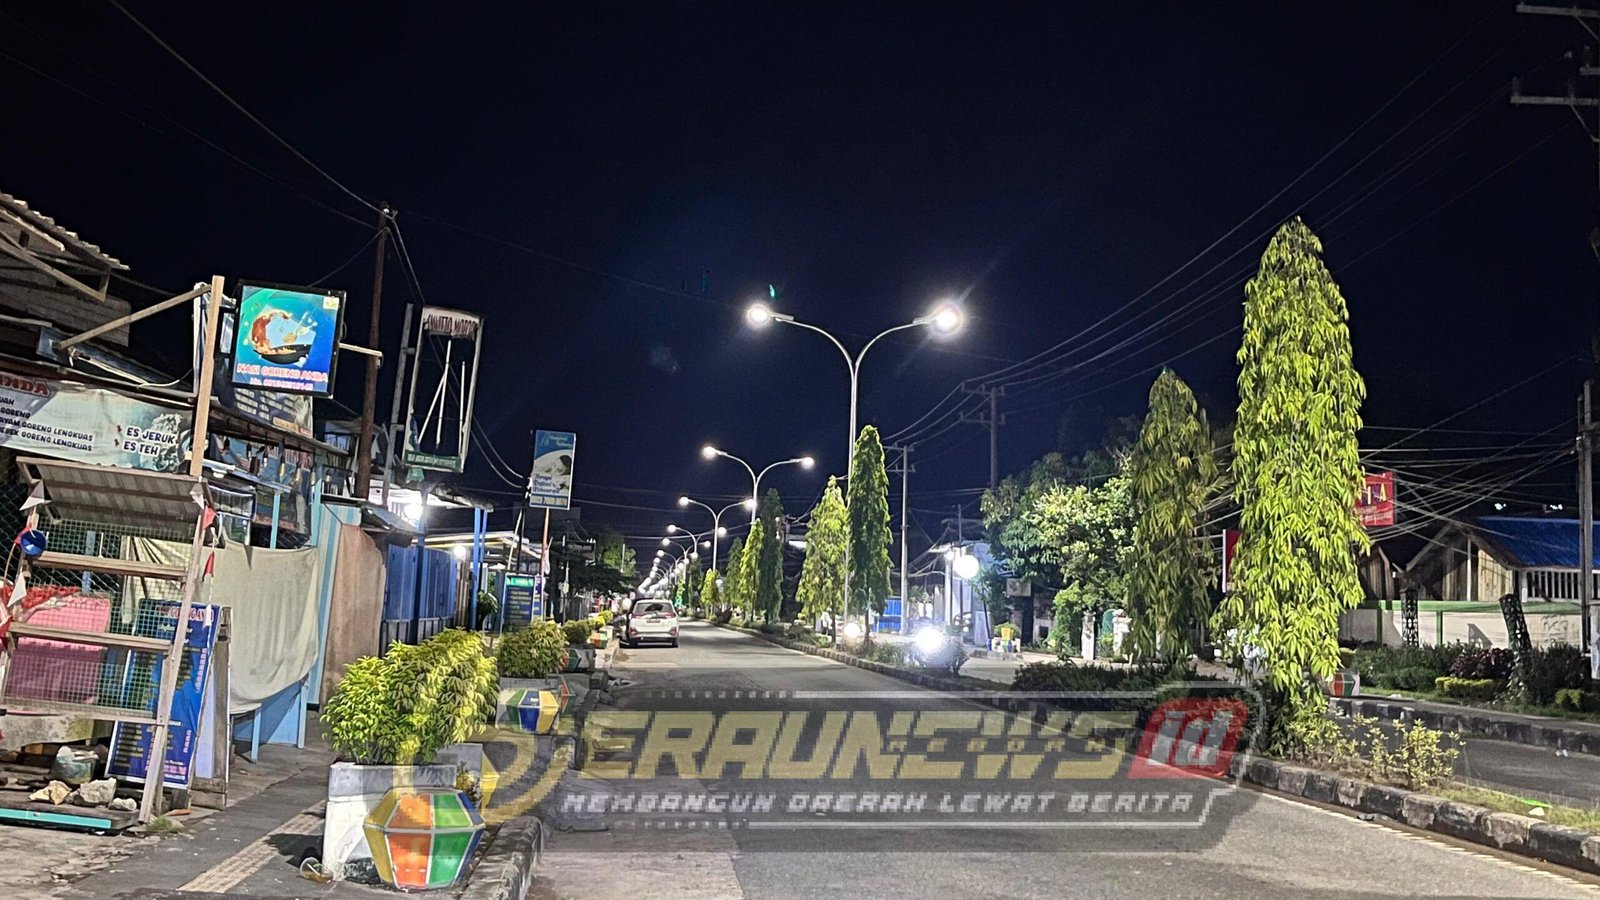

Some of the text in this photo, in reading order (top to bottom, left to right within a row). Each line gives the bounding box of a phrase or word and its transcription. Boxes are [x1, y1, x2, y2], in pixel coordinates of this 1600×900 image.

[53, 427, 94, 442] LENGKUAS
[126, 427, 176, 445] ES JERUK
[52, 437, 93, 452] LENGKUAS
[123, 440, 159, 456] ES TEH
